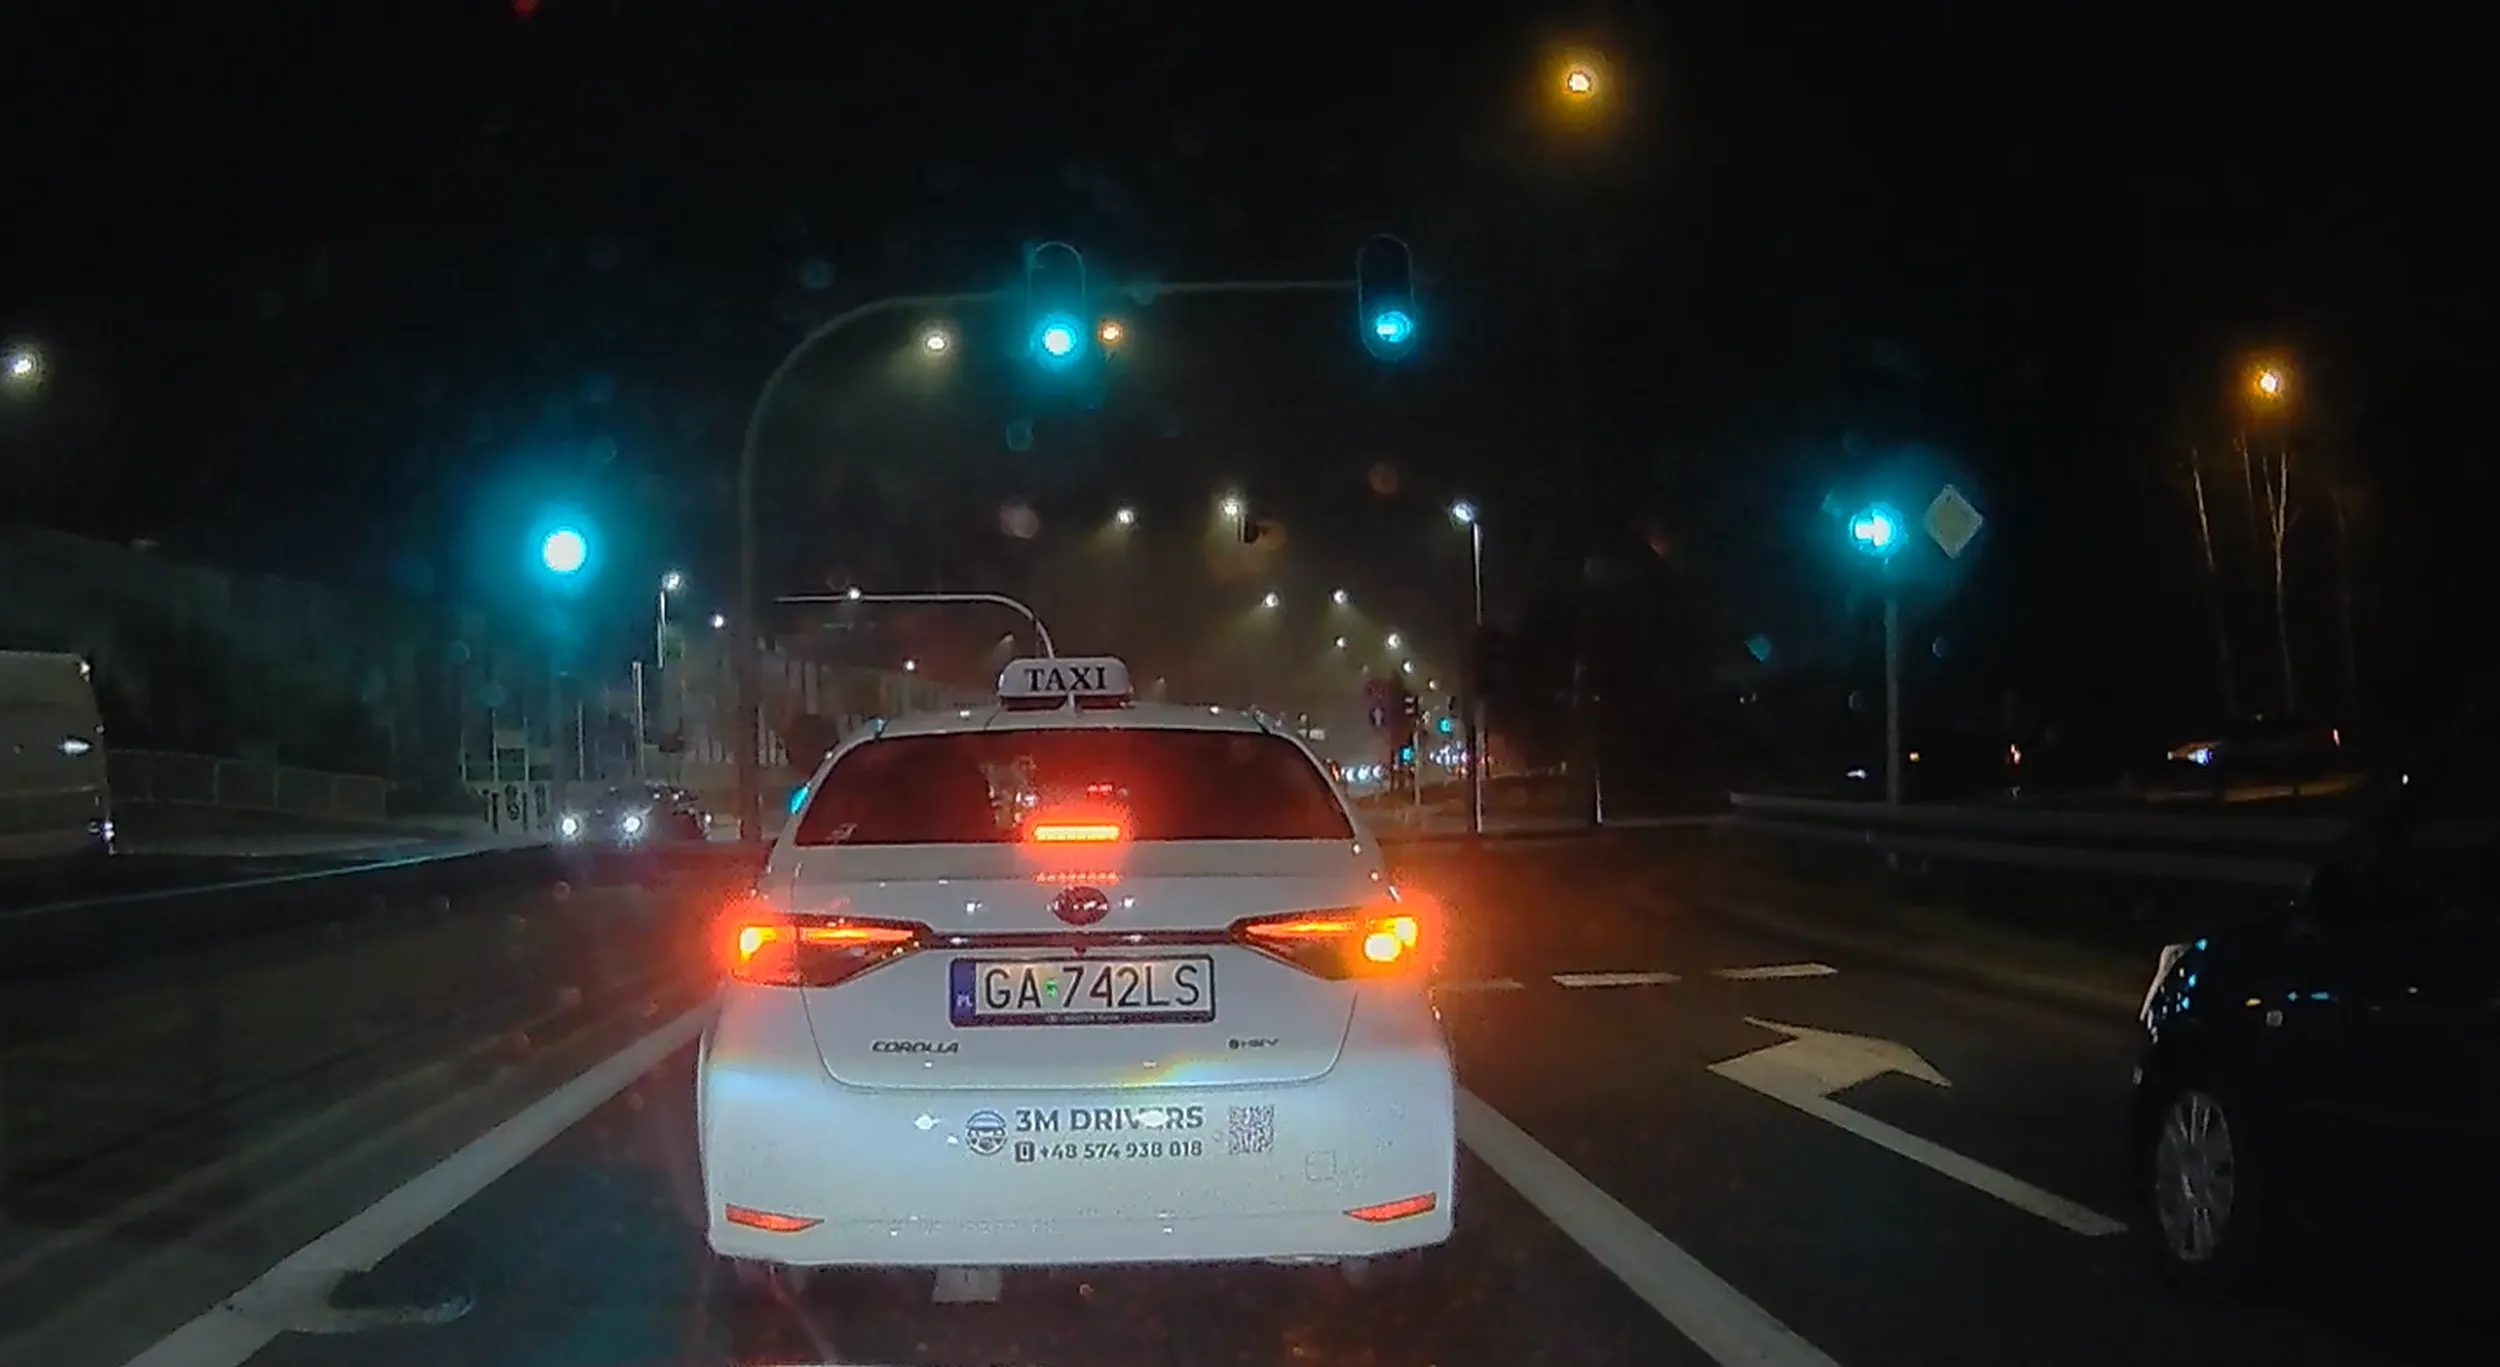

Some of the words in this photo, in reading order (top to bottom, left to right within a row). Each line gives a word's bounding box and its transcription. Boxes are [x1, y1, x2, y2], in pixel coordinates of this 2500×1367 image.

[1024, 667, 1107, 691] TAXI
[985, 968, 1042, 1009] GA
[1062, 964, 1200, 1008] 742LS
[872, 1041, 959, 1053] COROLLA
[1016, 1109, 1059, 1132] 3M
[1040, 1143, 1077, 1160] +48
[1084, 1142, 1120, 1159] 574
[1126, 1141, 1162, 1158] 938
[1170, 1140, 1202, 1157] 018
